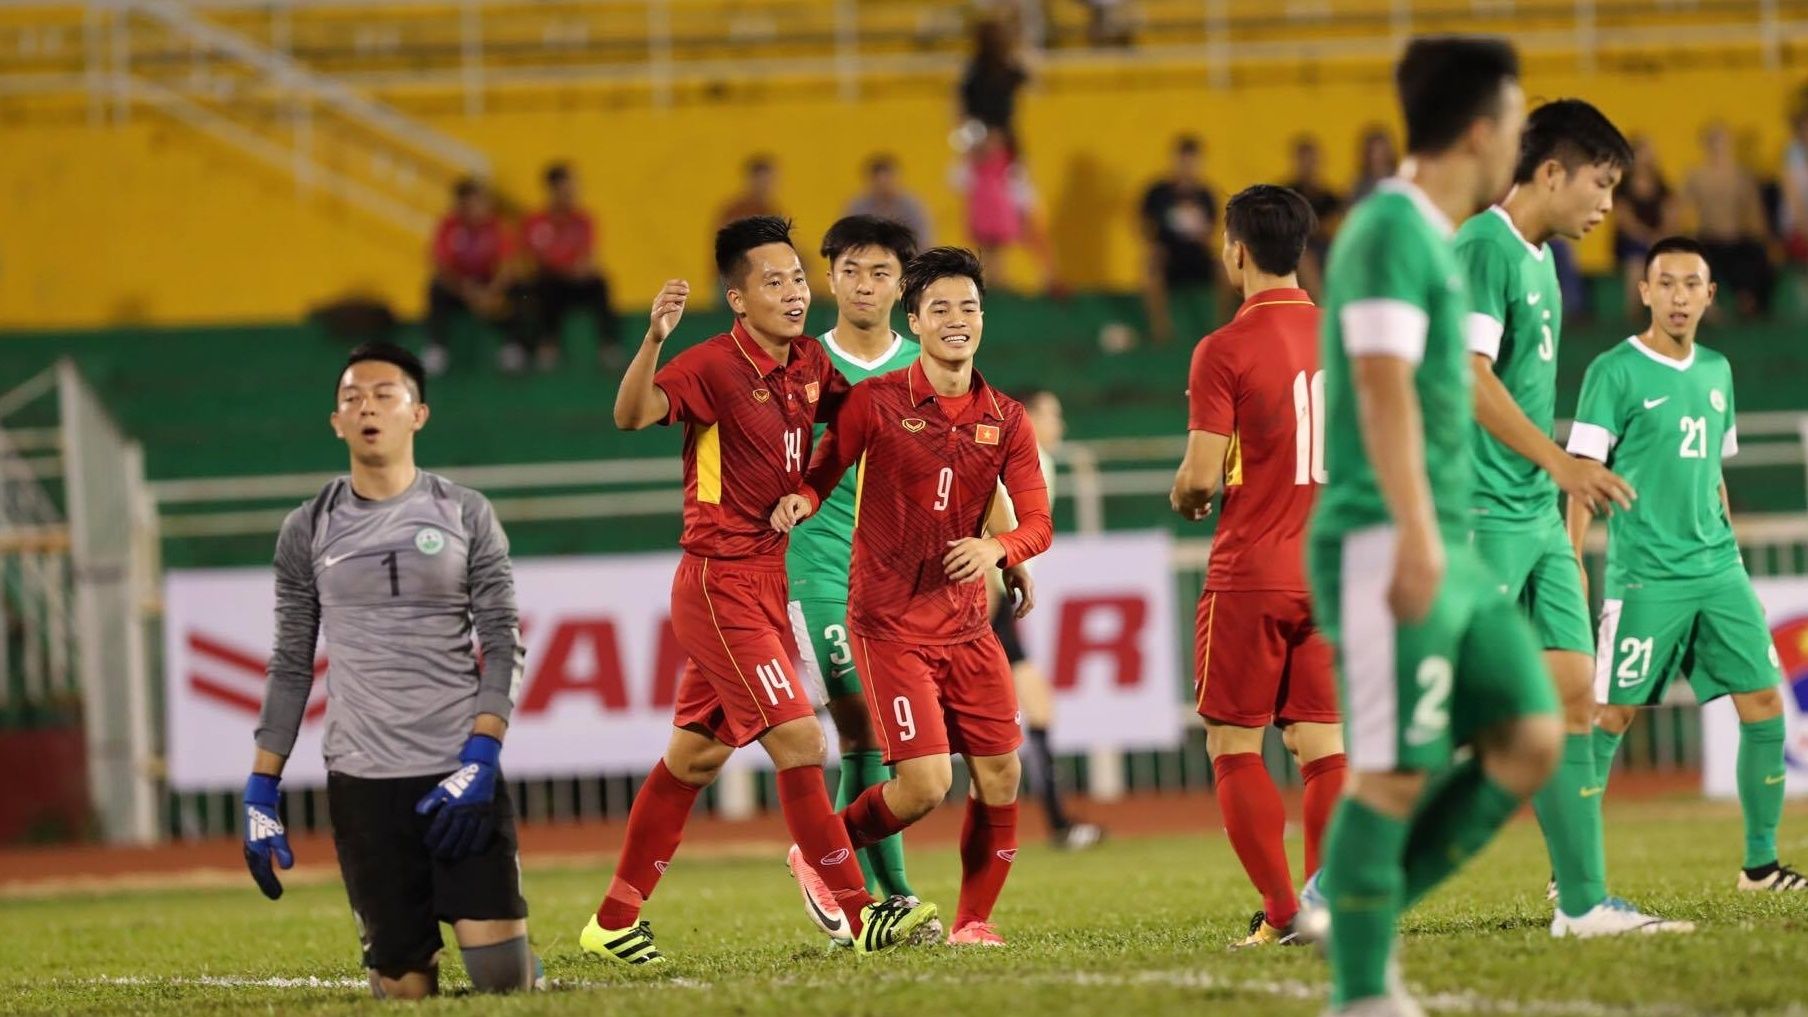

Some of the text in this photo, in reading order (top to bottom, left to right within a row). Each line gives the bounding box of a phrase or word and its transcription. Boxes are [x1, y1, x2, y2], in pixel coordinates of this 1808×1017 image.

[784, 427, 801, 472] 14
[1679, 416, 1707, 458] 21
[934, 467, 952, 511] 9
[381, 550, 399, 597] 1
[824, 624, 852, 665] 3
[1617, 637, 1654, 679] 21
[756, 658, 794, 705] 14
[1413, 655, 1453, 730] 2
[893, 695, 916, 741] 9
